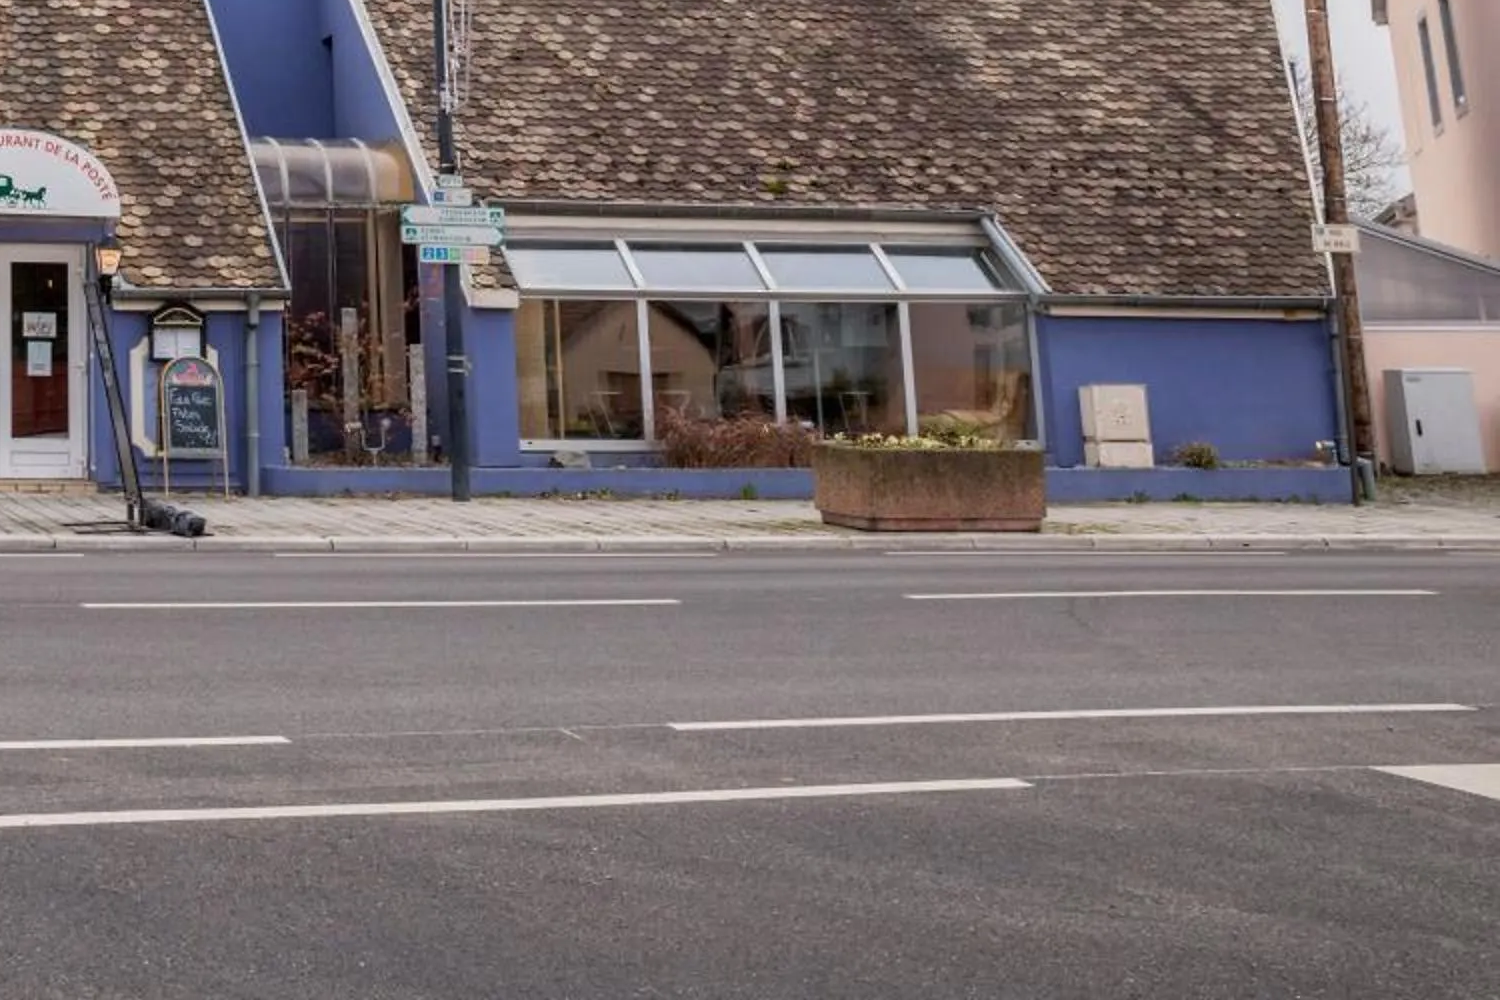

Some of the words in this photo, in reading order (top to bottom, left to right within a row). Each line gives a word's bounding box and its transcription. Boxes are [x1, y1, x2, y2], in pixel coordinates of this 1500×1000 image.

[45, 141, 63, 155] DE
[65, 150, 80, 165] LA
[81, 160, 113, 201] POSTE
